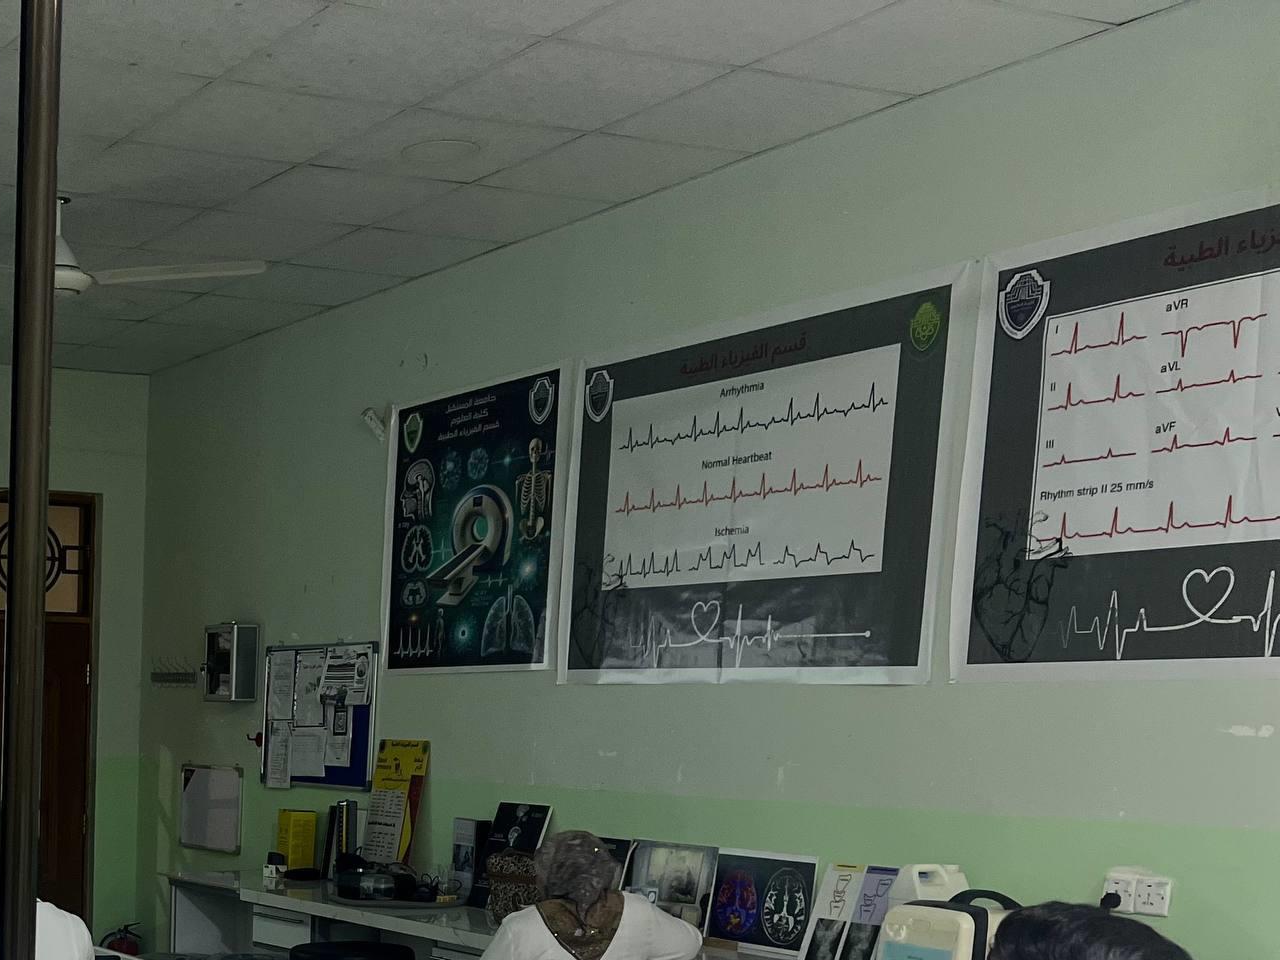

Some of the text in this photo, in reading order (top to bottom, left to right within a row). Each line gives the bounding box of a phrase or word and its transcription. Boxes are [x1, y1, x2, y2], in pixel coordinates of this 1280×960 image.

[1166, 299, 1188, 312] aVR
[1055, 325, 1059, 334] I
[1160, 361, 1181, 373] aVL
[720, 382, 764, 398] Arrhythmia
[1155, 421, 1177, 434] aVF
[702, 451, 771, 469] Normal Heartbeat
[1040, 487, 1074, 501] Rhythm
[1077, 486, 1098, 498] strip
[1110, 483, 1123, 493] 25
[1126, 480, 1154, 492] mm/s
[715, 526, 749, 537] Ischemia
